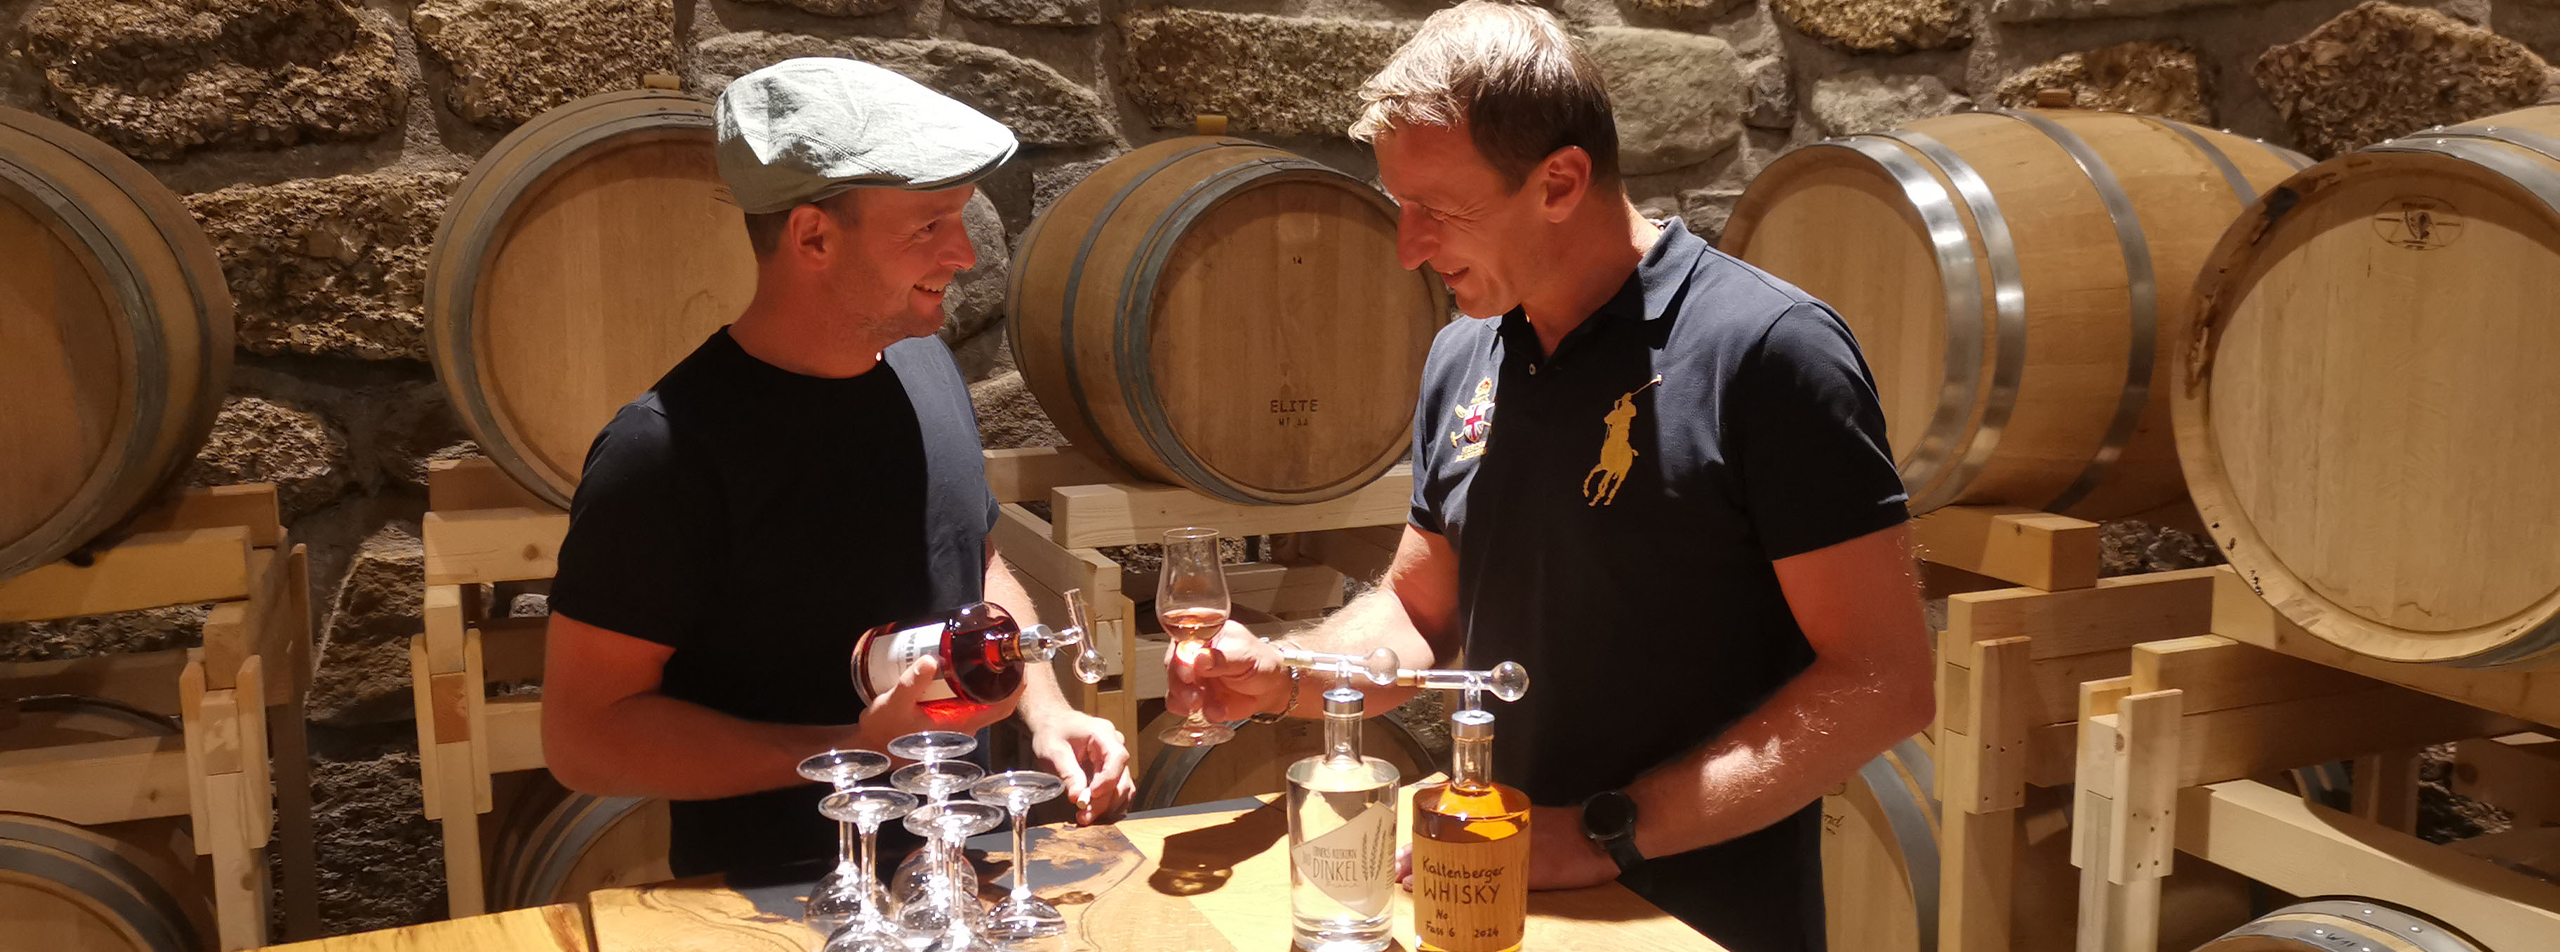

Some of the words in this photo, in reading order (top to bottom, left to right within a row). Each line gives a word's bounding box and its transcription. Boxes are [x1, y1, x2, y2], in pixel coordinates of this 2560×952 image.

[1270, 399, 1319, 413] ELITE
[1313, 857, 1358, 882] DINKEL
[1422, 856, 1505, 884] Kaltenberger
[1423, 876, 1501, 905] WHISKY
[1426, 920, 1444, 936] Fass
[1448, 927, 1456, 938] 6
